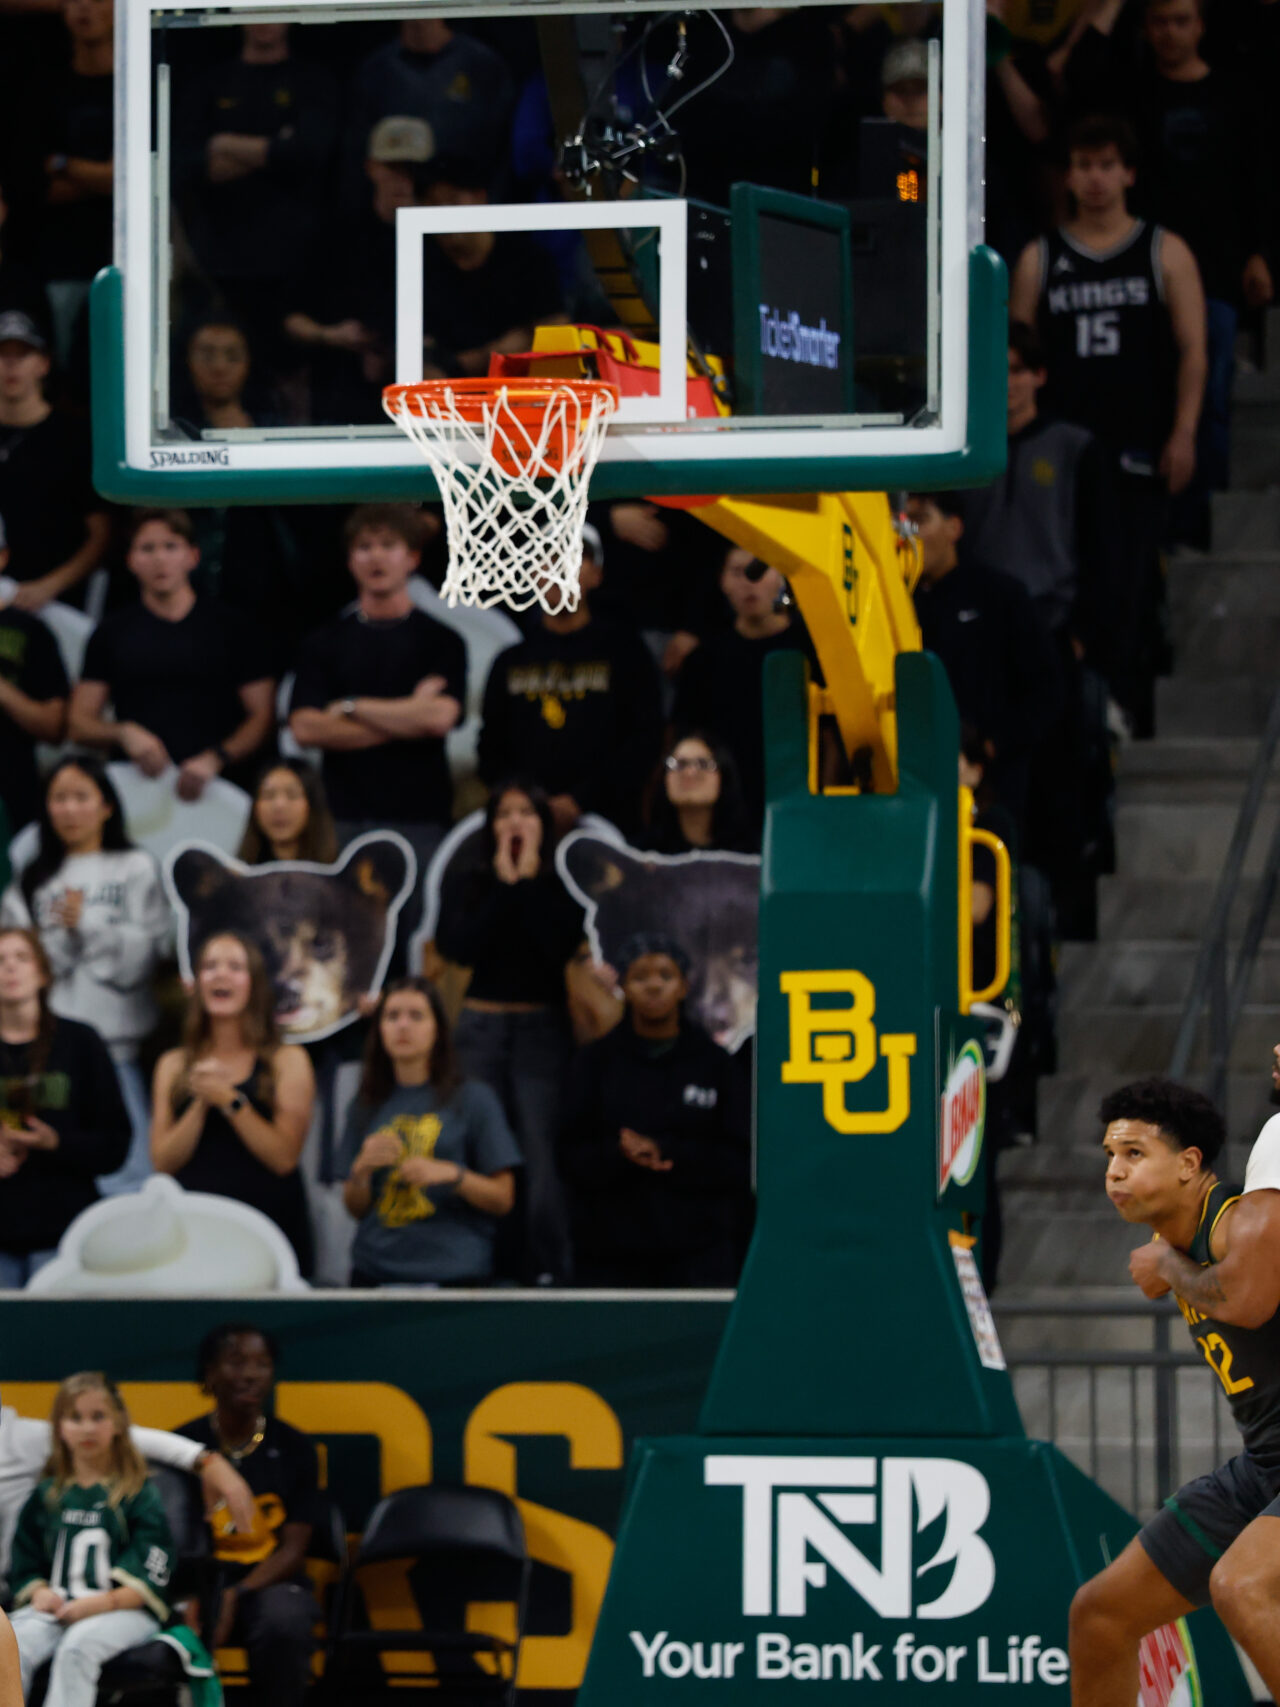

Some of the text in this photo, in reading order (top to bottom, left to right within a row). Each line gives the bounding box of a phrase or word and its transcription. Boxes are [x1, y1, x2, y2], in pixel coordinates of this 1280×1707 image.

[1076, 310, 1121, 358] 15
[150, 447, 230, 469] SPALDING
[779, 968, 918, 1135] BU
[49, 1526, 114, 1601] 10
[628, 1630, 1070, 1686] Your Bank for Life
